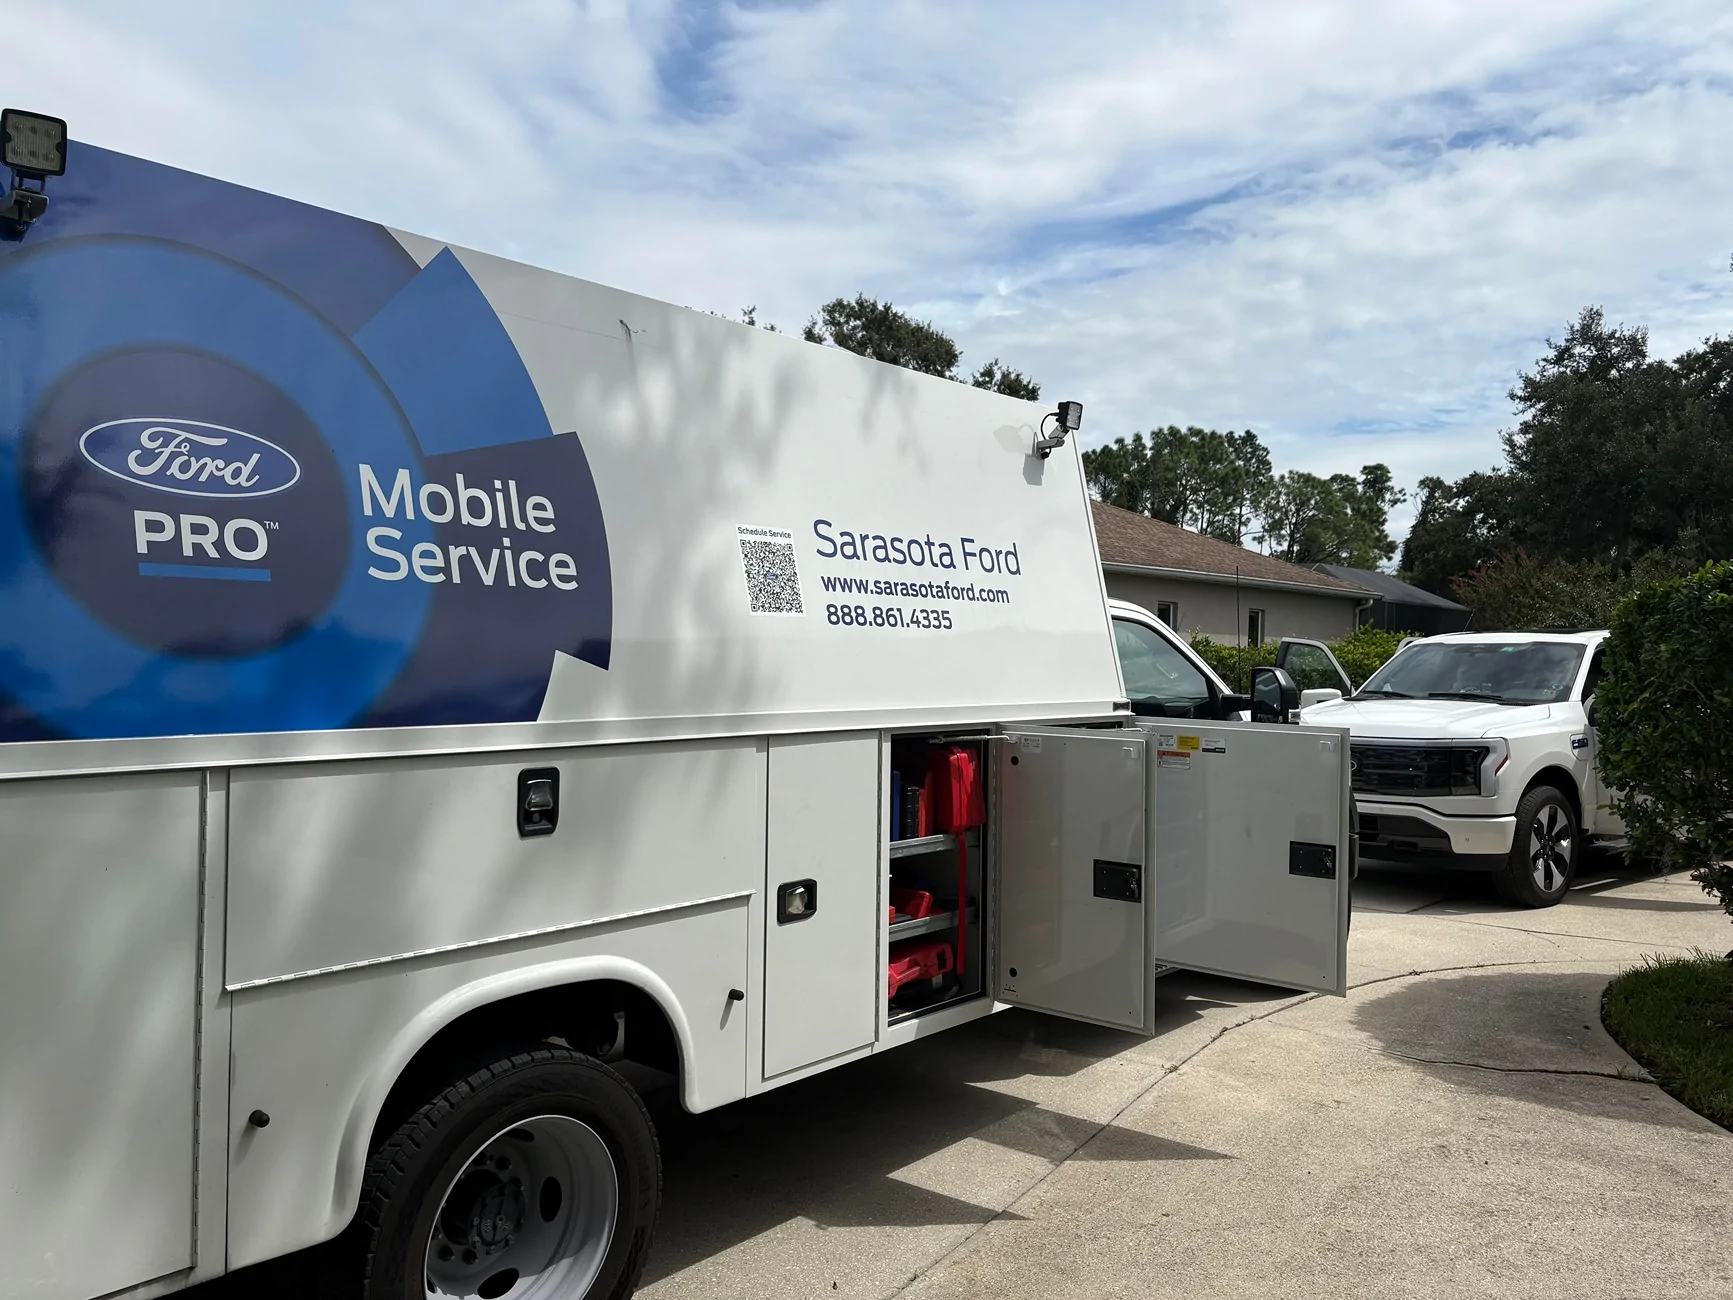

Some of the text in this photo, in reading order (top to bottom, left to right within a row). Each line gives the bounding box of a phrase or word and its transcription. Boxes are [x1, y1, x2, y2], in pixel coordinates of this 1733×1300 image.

[127, 426, 260, 488] Ford
[358, 463, 555, 533] Mobile
[366, 526, 579, 591] Service
[737, 526, 792, 539] Schedule Service
[812, 519, 1022, 576] Sarasota Ford
[821, 575, 1010, 604] www.sarasotaford.com
[826, 603, 953, 630] 888.861.4335
